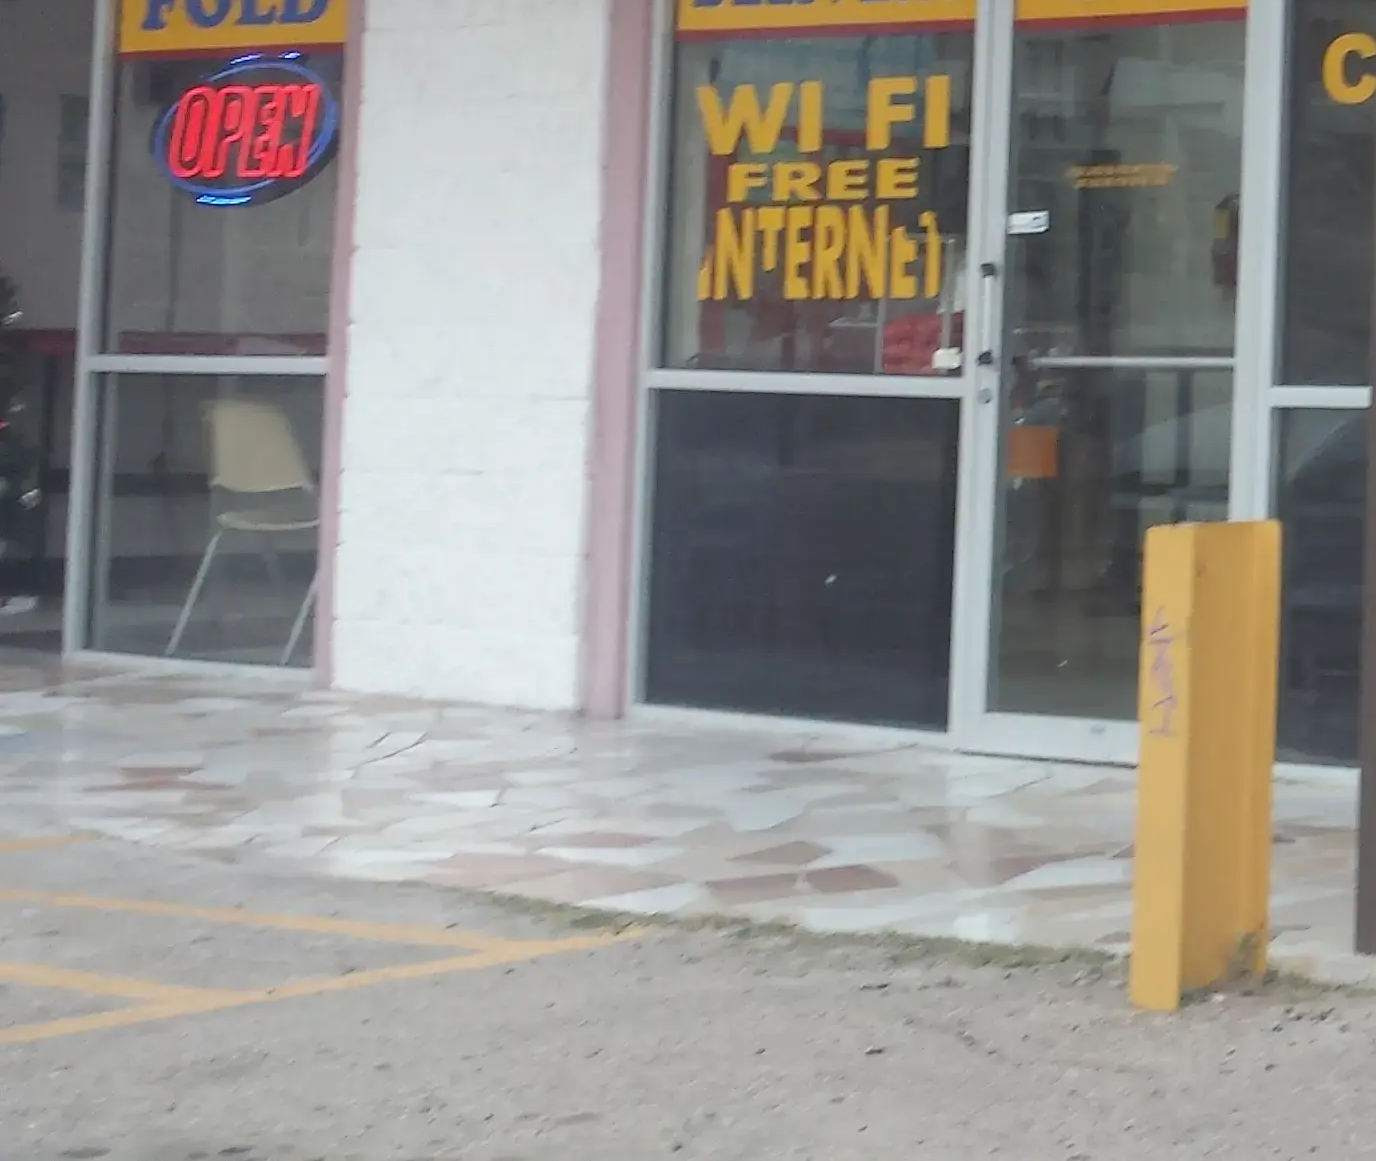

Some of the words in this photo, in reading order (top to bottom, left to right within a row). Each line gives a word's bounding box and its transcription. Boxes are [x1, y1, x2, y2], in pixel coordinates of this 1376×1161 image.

[168, 84, 322, 177] OPEN
[696, 80, 822, 155] WI
[866, 75, 949, 151] FI
[726, 157, 920, 202] FREE
